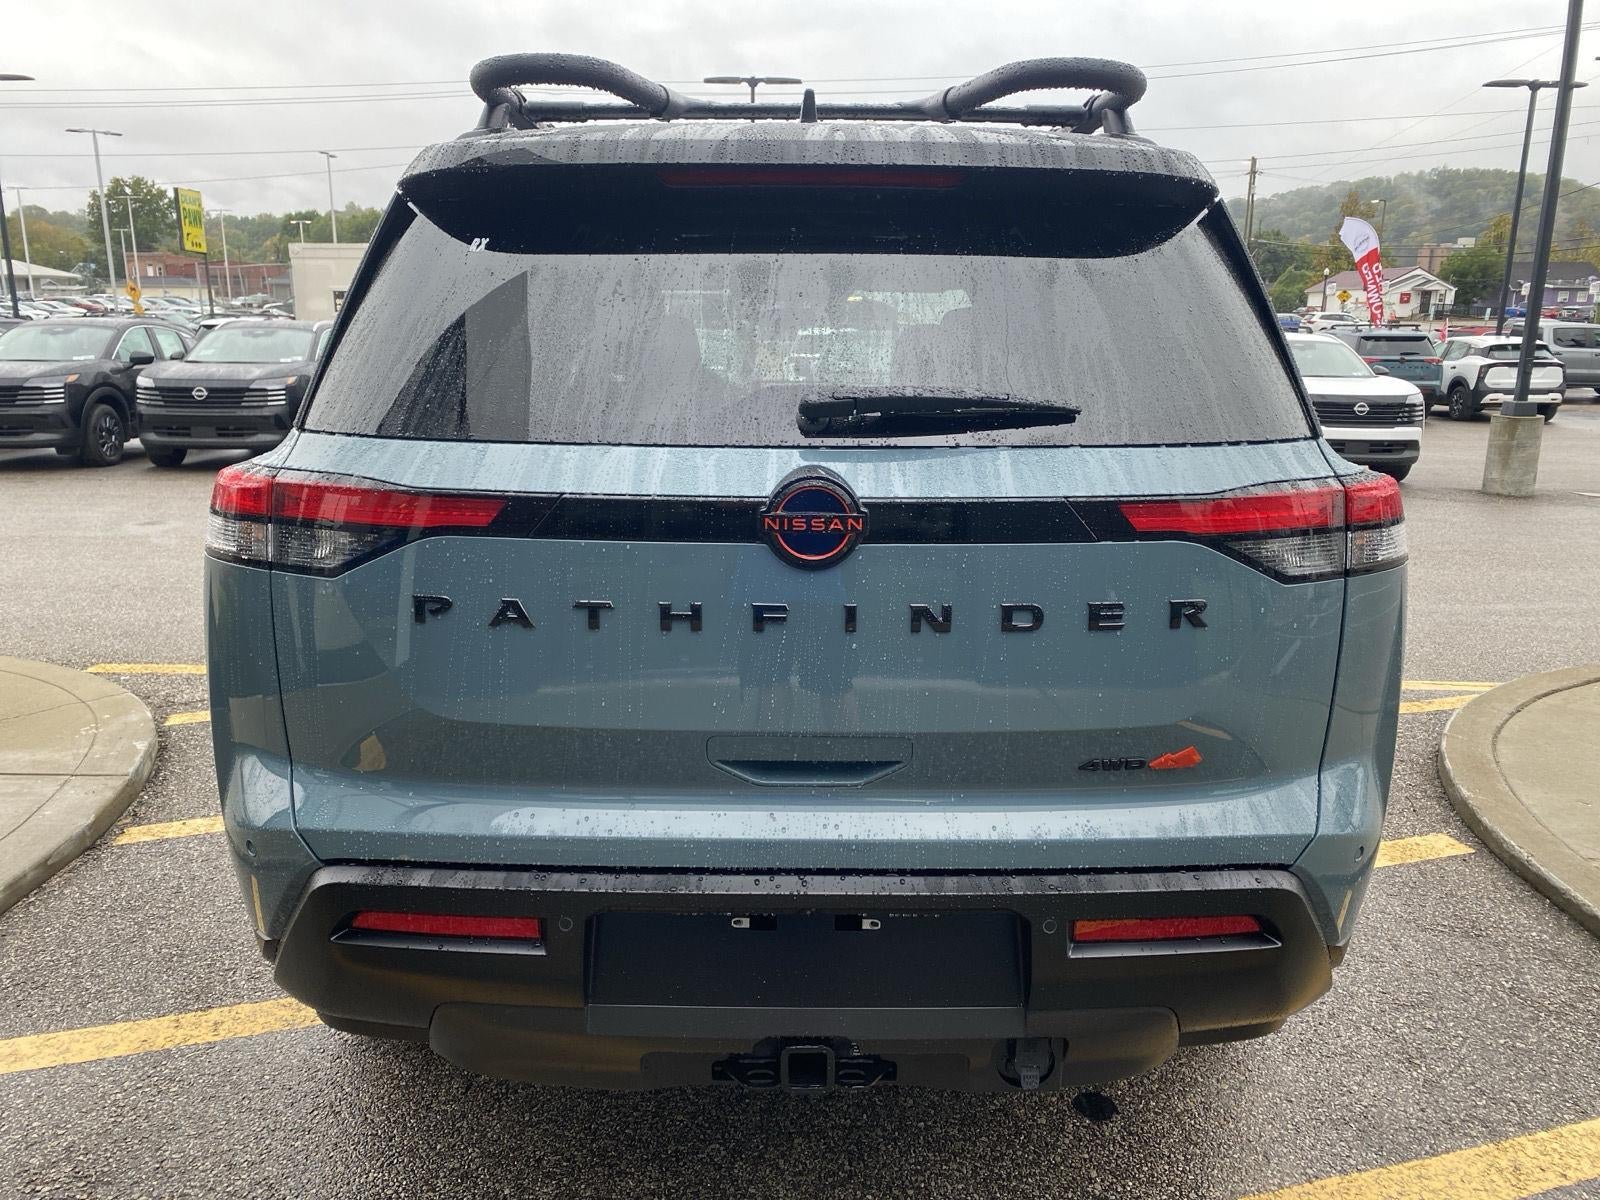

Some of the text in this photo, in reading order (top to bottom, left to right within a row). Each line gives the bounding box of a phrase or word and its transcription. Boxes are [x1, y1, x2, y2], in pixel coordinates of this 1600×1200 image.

[182, 206, 203, 229] PAWN
[763, 517, 863, 532] NISSAN
[412, 594, 1208, 633] PATHFINDER
[1078, 757, 1147, 771] 4WD
